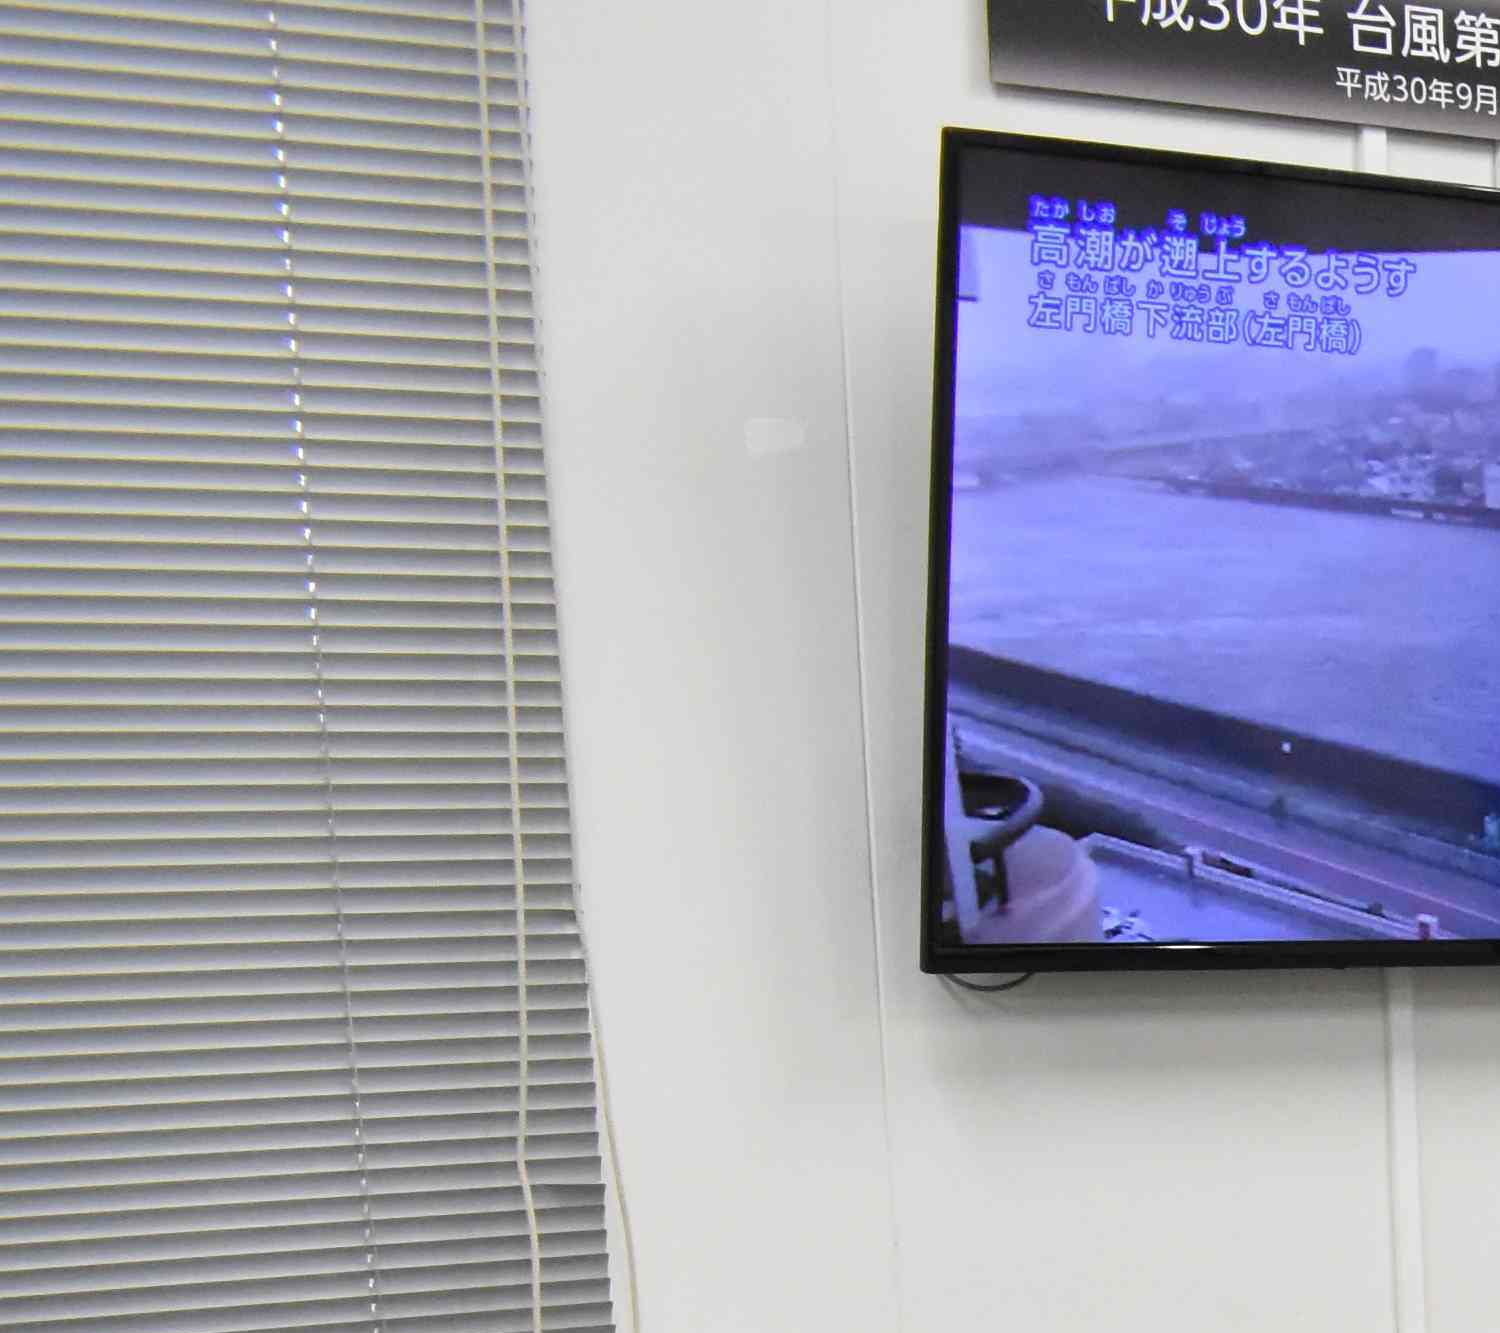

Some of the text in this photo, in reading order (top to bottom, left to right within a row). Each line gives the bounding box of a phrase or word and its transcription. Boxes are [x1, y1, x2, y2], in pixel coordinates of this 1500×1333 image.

[1030, 222, 1416, 298] 高潮が遡上するようす
